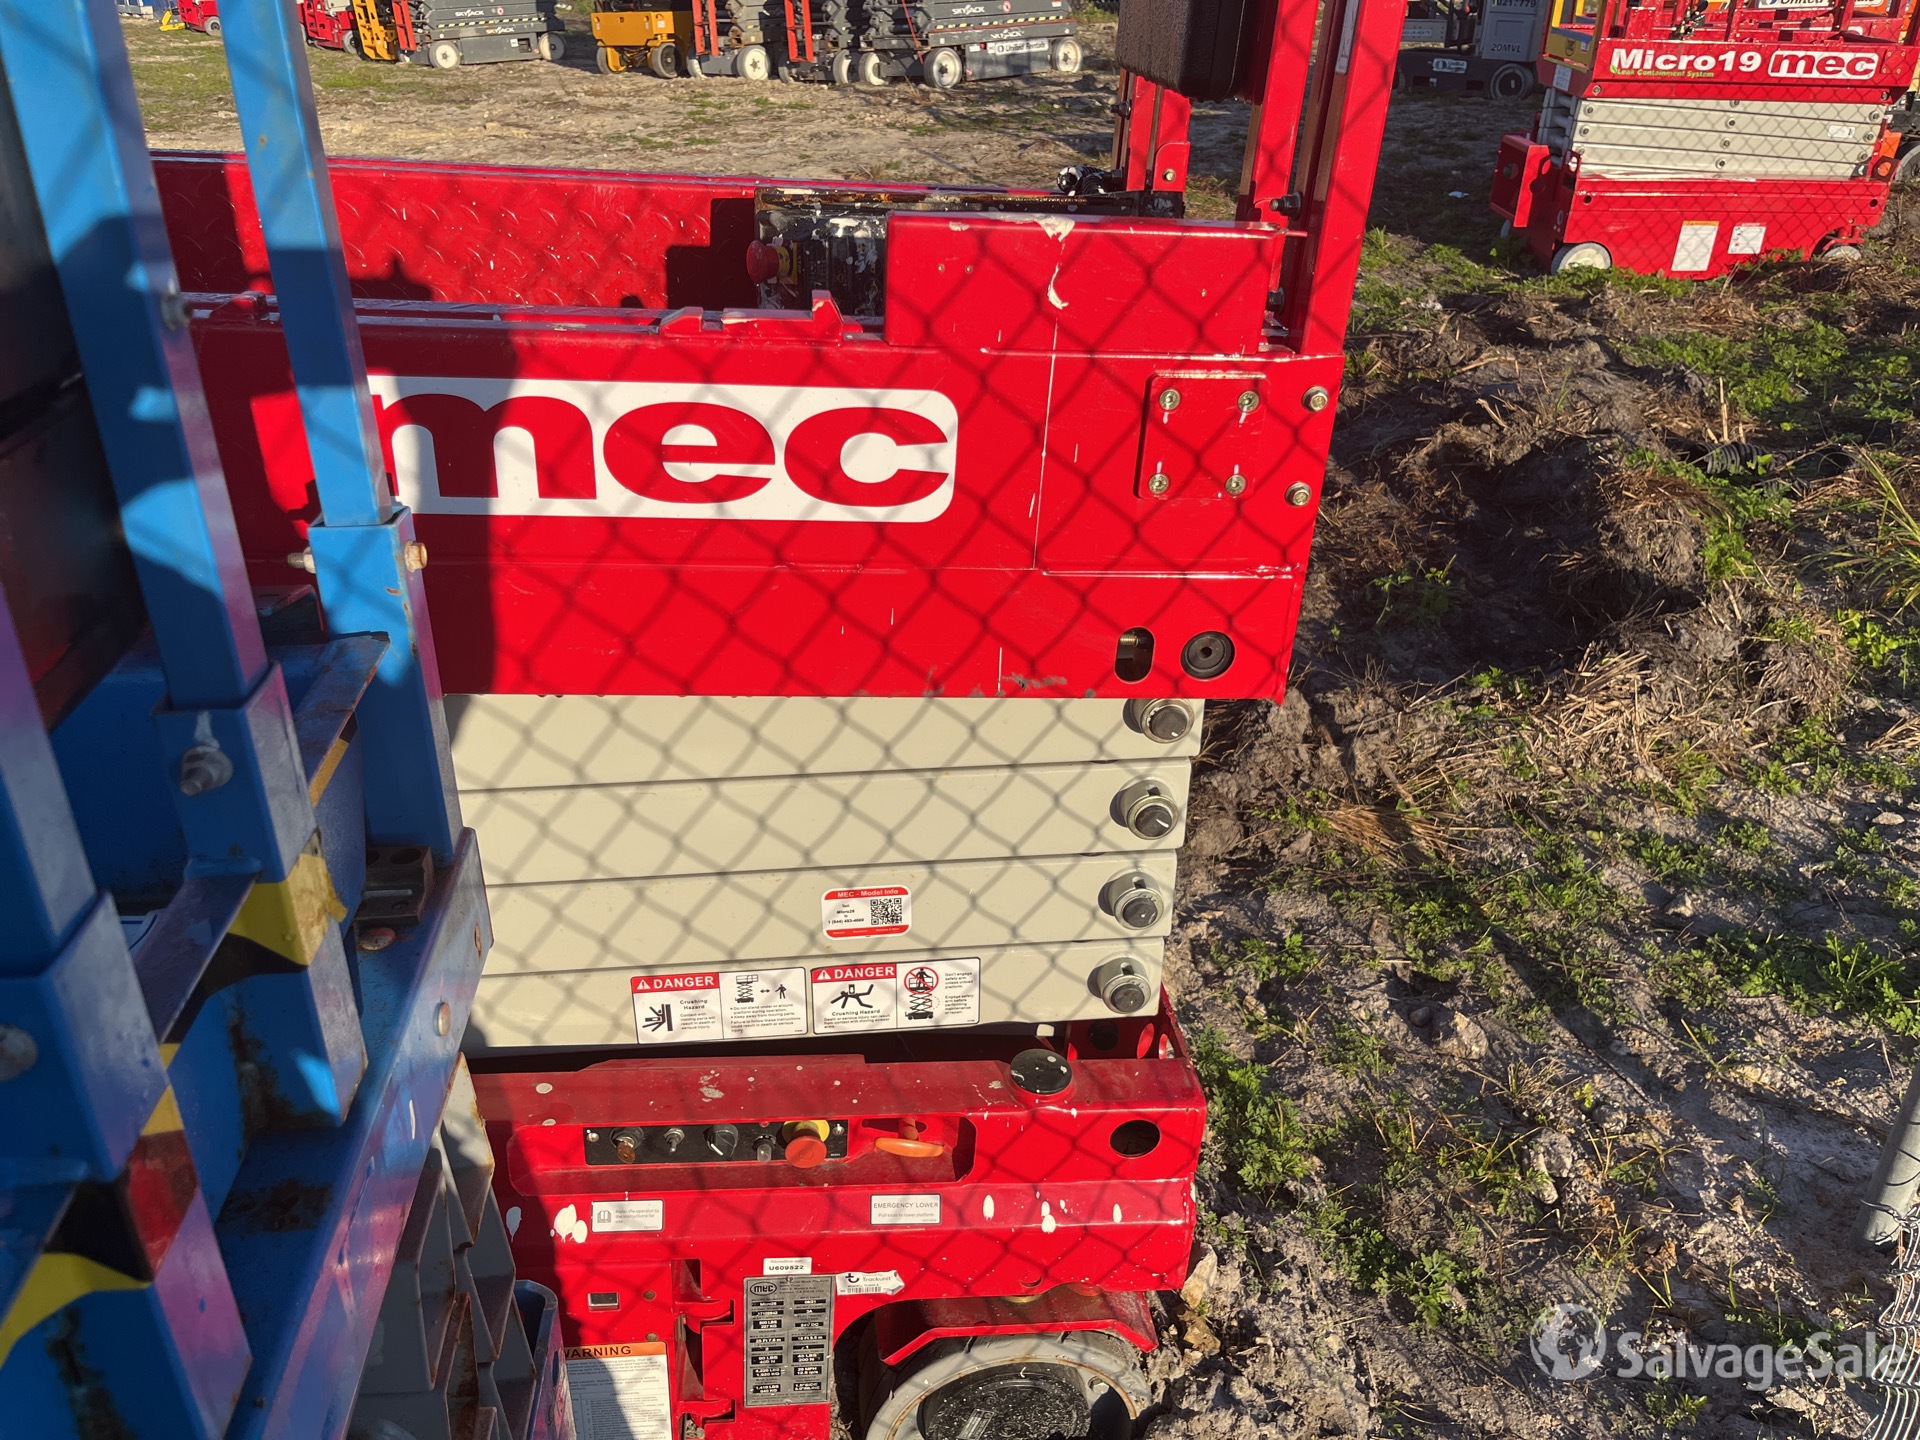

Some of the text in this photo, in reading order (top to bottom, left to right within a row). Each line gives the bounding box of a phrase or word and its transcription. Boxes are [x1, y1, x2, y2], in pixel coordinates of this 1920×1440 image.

[455, 9, 484, 17] SKYJACK
[952, 5, 985, 15] SKYJACK
[486, 26, 514, 35] SKYJACK
[1610, 48, 1876, 76] Micro19 mec
[1637, 69, 1685, 77] Containment
[1687, 70, 1714, 78] System
[372, 393, 950, 507] mec
[834, 966, 894, 979] DANGER
[653, 976, 714, 989] DANGER
